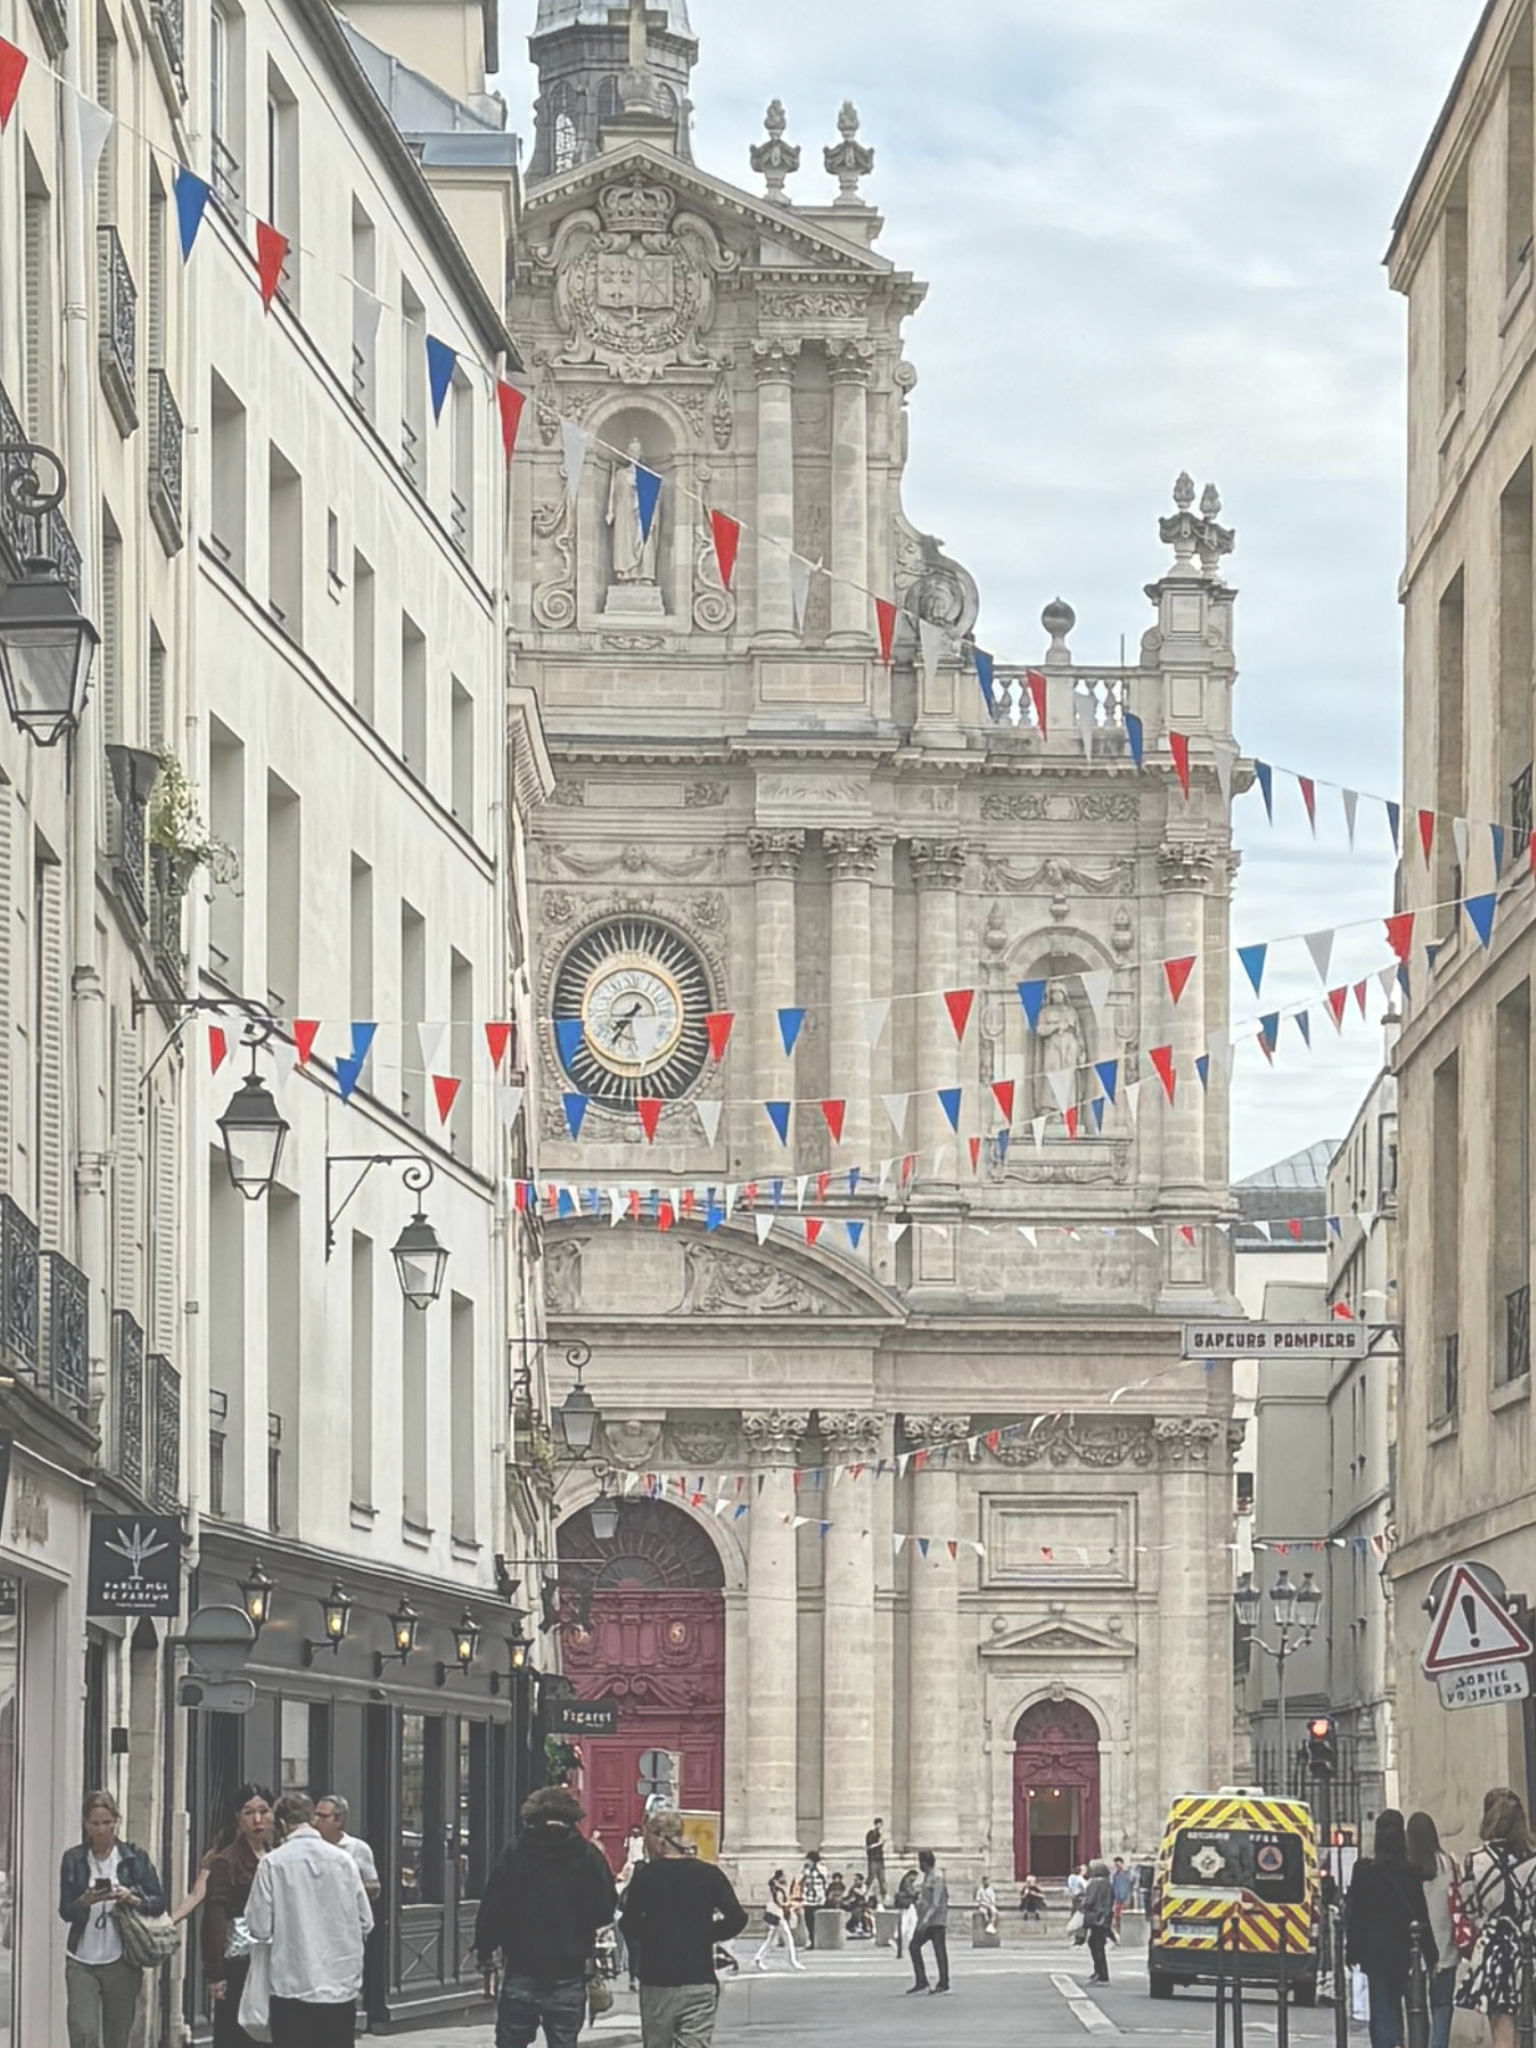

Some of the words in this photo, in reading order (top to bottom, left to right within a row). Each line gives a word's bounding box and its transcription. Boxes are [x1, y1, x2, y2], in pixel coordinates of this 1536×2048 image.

[1194, 1333, 1267, 1348] SAPEURS
[1274, 1333, 1356, 1348] POMPIERS
[1455, 1669, 1508, 1689] SORTIE
